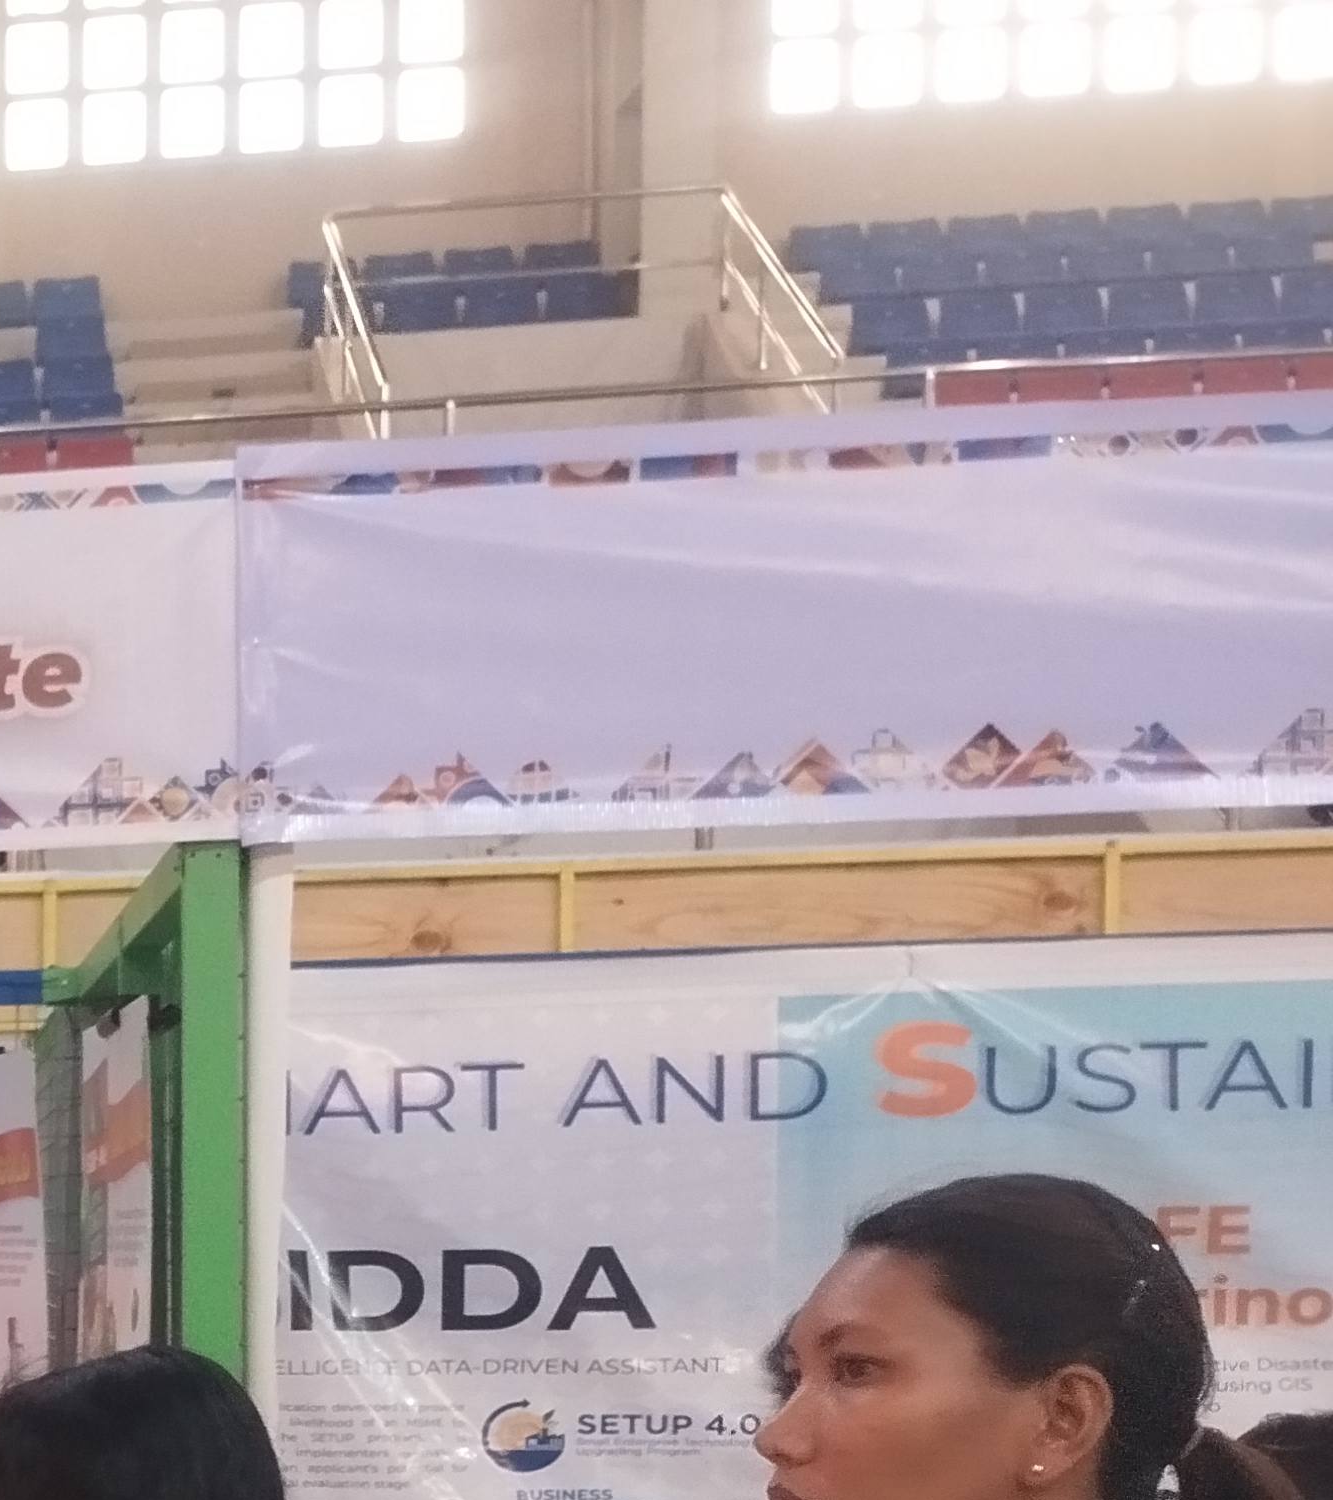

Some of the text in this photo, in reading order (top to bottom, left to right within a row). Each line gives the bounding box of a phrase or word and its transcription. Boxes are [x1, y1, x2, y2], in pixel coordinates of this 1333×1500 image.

[286, 1020, 1314, 1136] ART AND SUSTAI
[1157, 1205, 1250, 1254] FE
[278, 1246, 655, 1331] IDDA
[407, 1359, 579, 1376] DATA-DRIVEN
[588, 1356, 724, 1373] ASSISTANT
[1278, 1377, 1313, 1392] GIS
[577, 1413, 761, 1436] SETUP 4.0
[516, 1489, 613, 1500] BUSINESS
